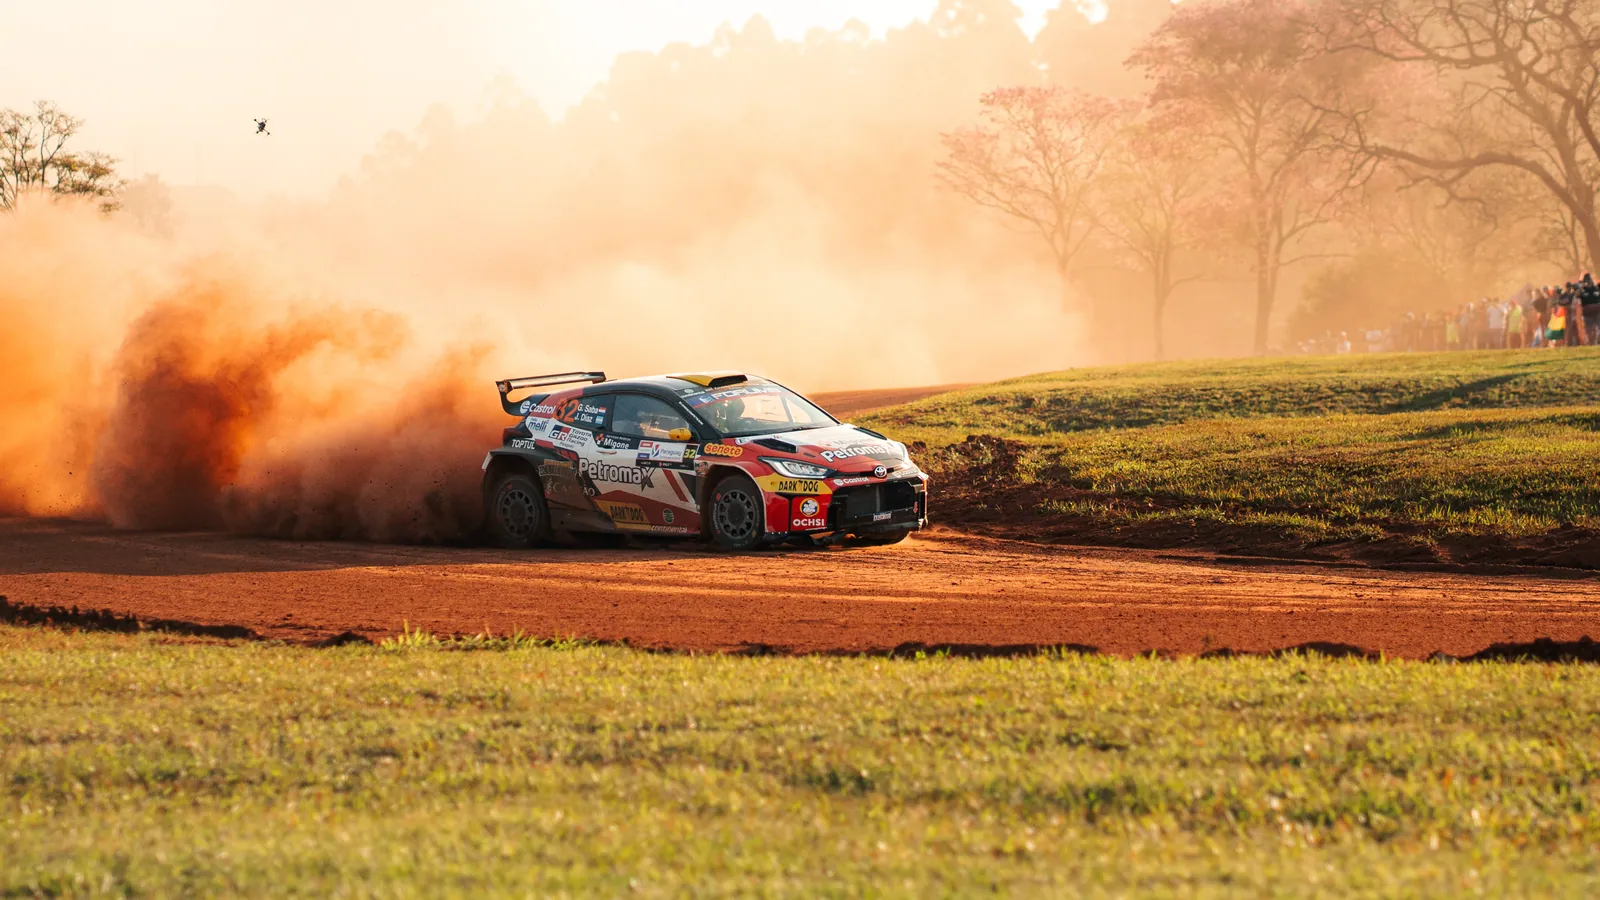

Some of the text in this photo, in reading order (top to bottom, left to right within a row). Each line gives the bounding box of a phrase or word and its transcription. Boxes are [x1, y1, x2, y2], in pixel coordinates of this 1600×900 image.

[529, 403, 556, 414] Castrol
[578, 404, 583, 412] G.
[549, 429, 569, 441] GR
[568, 433, 588, 442] GAZOO
[572, 429, 592, 437] TOYOTA
[511, 439, 536, 450] TOPTUL
[603, 437, 629, 450] Migone
[660, 447, 683, 457] Paraguay
[683, 448, 696, 459] 32
[705, 442, 743, 457] senete
[843, 476, 870, 484] Castrol
[778, 480, 819, 493] DARK DOG
[792, 518, 825, 527] OCHSI
